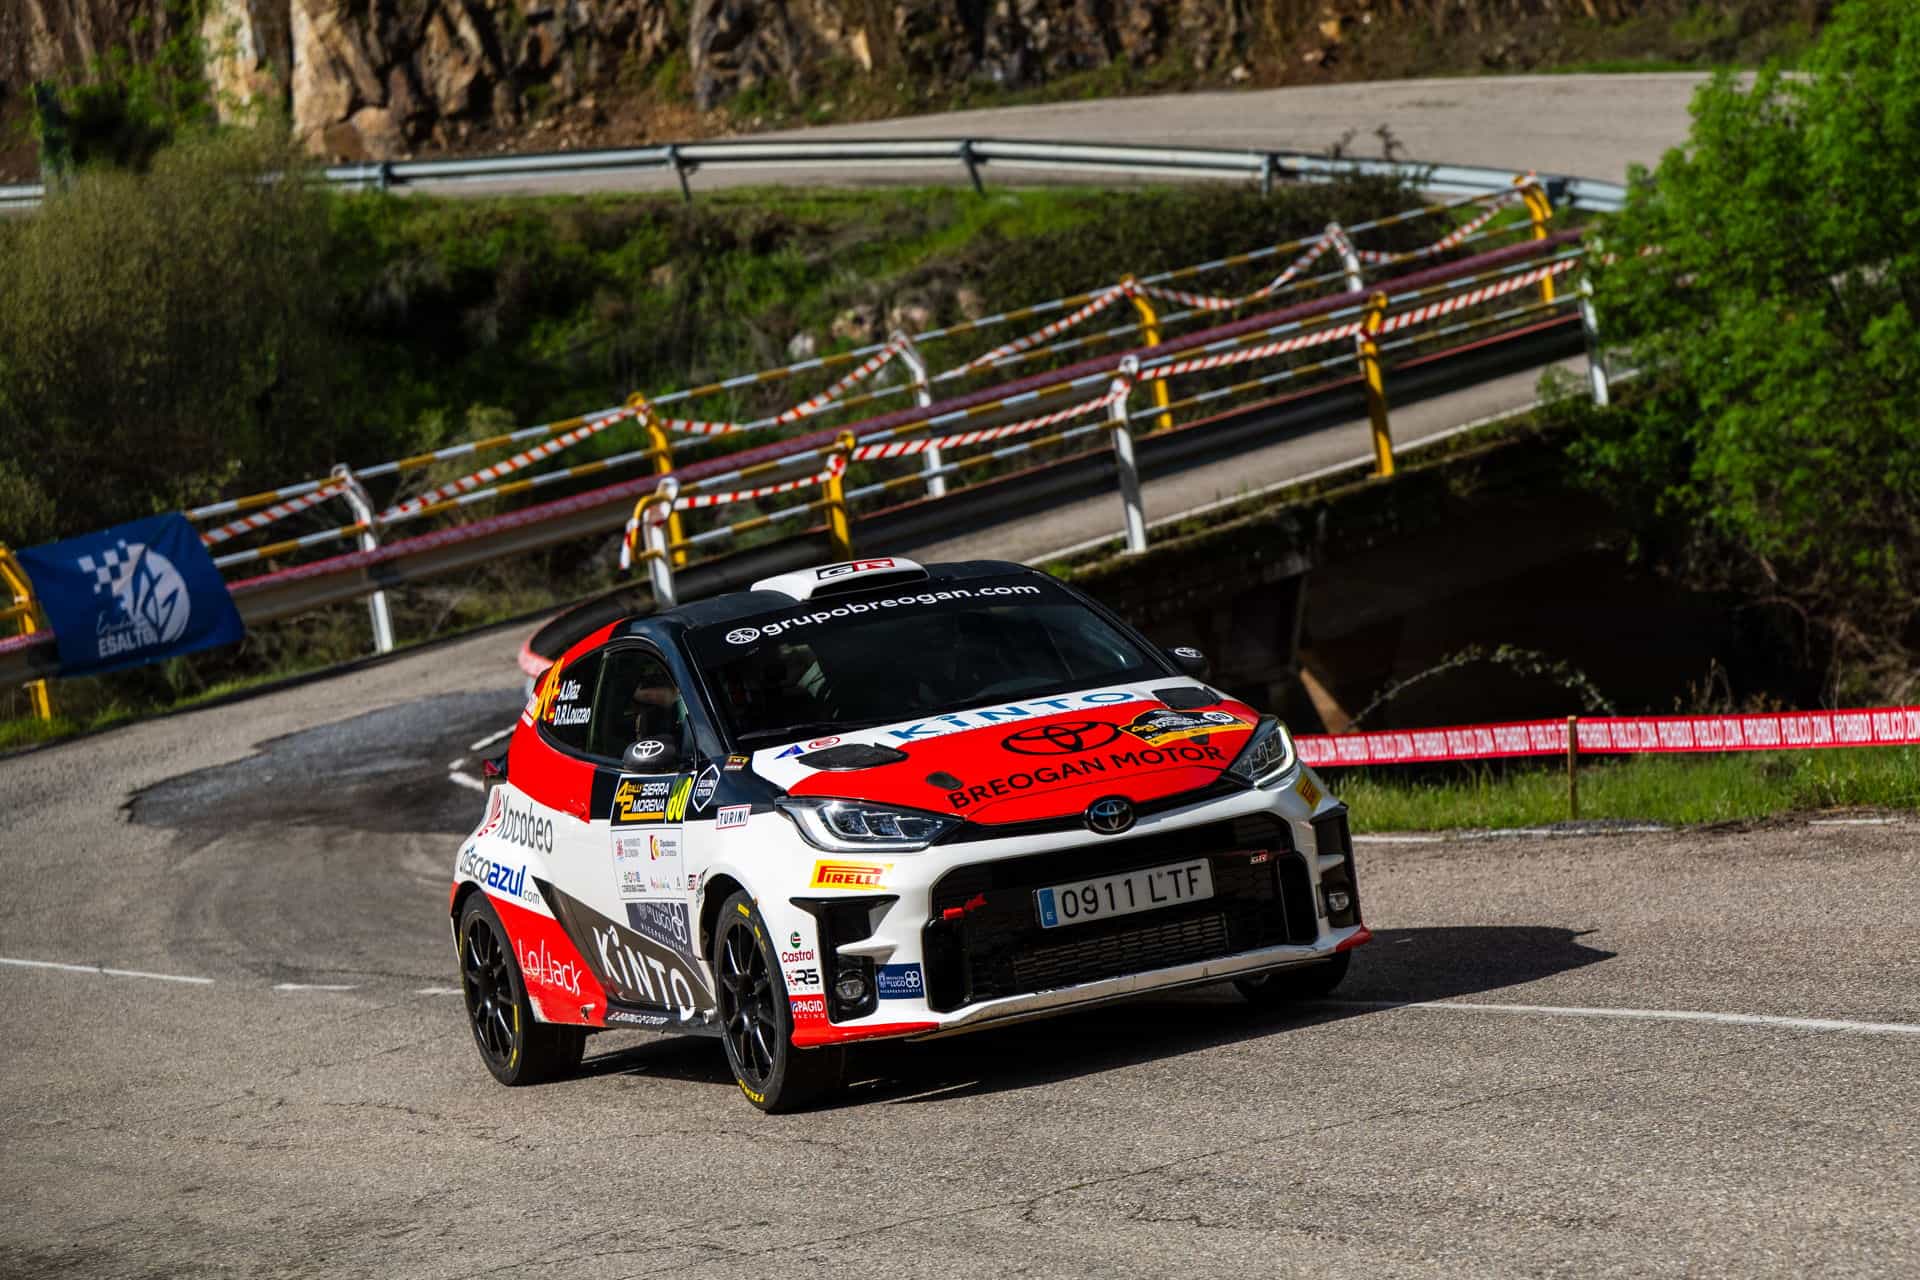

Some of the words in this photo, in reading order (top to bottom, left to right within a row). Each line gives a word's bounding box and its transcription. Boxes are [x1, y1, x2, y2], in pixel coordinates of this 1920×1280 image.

[816, 558, 895, 580] GR
[761, 583, 1041, 636] grupobreogan.com
[950, 757, 1106, 809] BREOGAN
[1111, 745, 1228, 769] MOTOR
[641, 782, 670, 797] SIERRA
[632, 799, 665, 813] MORENA
[720, 810, 747, 824] TURINI
[817, 865, 883, 885] PIRELLI
[1061, 878, 1136, 919] 0911
[1149, 866, 1203, 903] LTF
[782, 949, 814, 963] Castrol
[797, 1000, 824, 1013] PAGID
